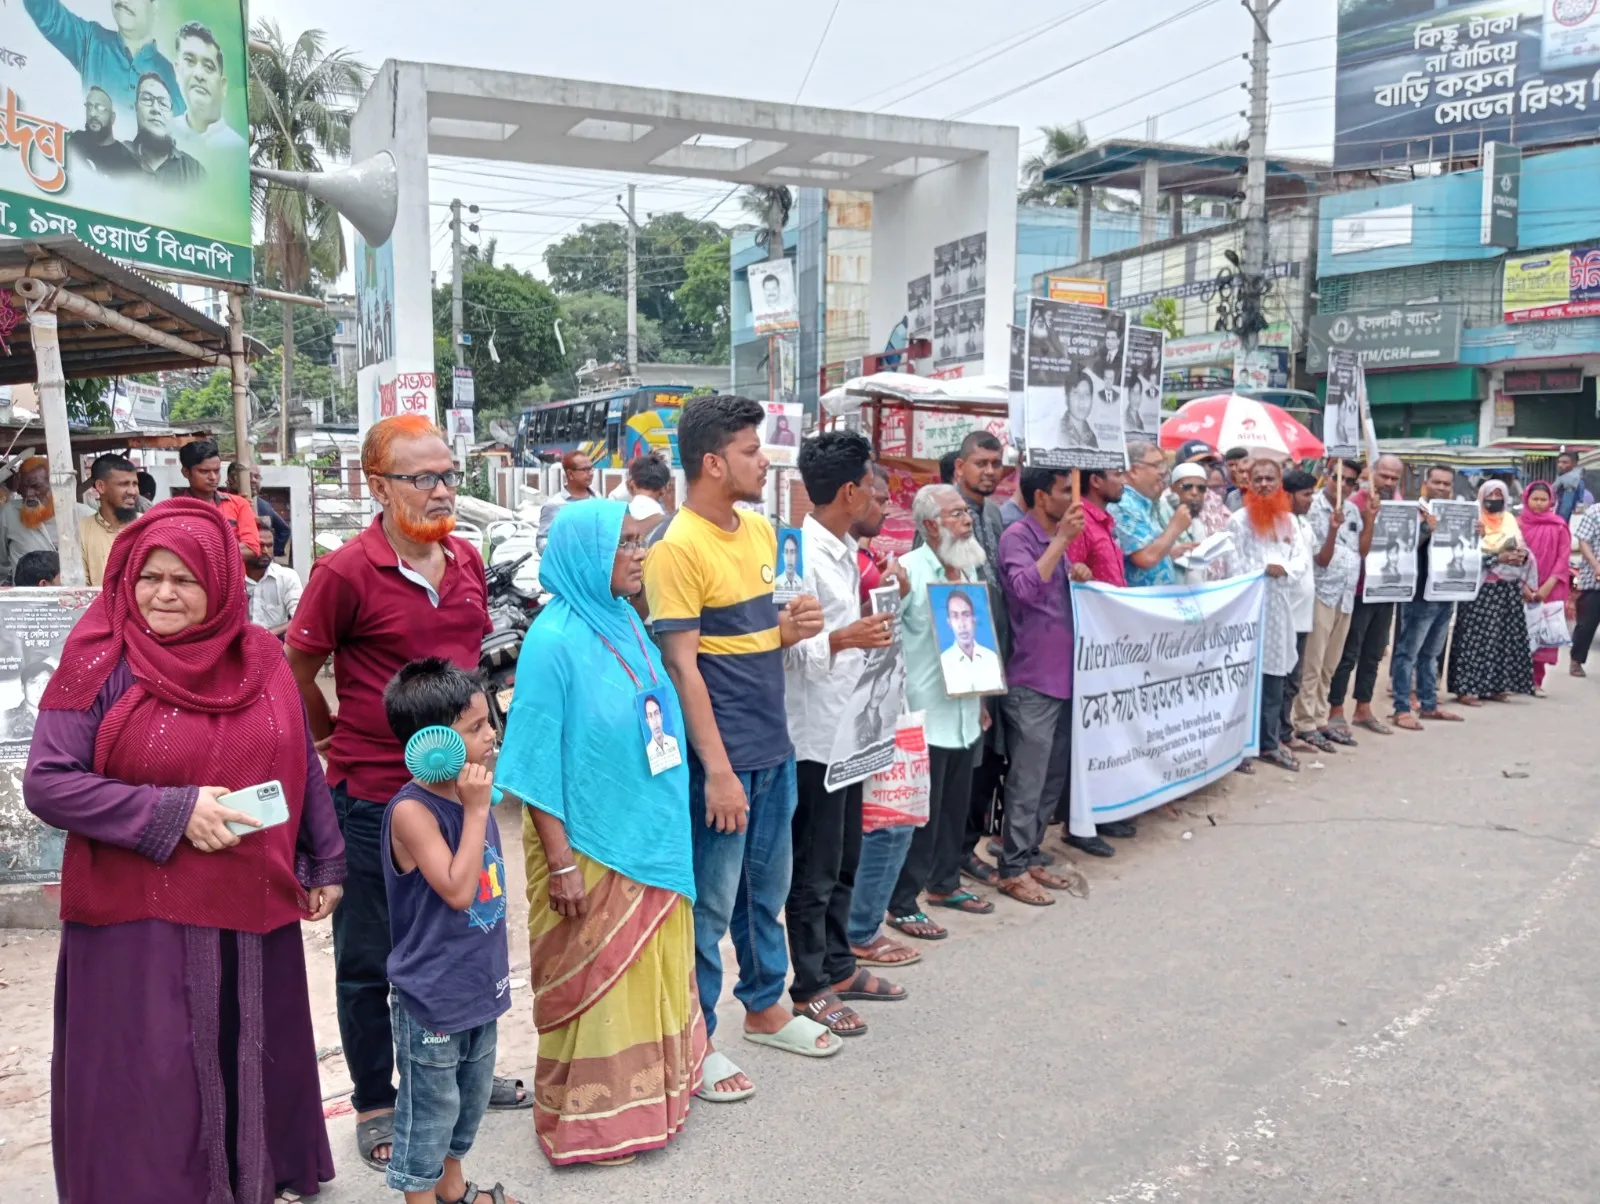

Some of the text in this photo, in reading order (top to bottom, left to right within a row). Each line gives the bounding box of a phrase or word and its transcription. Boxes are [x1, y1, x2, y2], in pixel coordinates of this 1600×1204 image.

[1414, 22, 1460, 52] কিছু
[1469, 13, 1521, 39] টাকা
[1426, 40, 1518, 73] না বাঁচিয়ে
[1374, 64, 1516, 108] বাড়ি করুন
[1435, 92, 1515, 124] সেভেন
[1520, 78, 1587, 111] রিংস্
[30, 208, 77, 234] ৯নং
[89, 224, 150, 253] ওয়ার্ড
[156, 230, 234, 272] বিএনপি
[1357, 310, 1402, 331] ইসলামী
[1237, 432, 1267, 441] airtel
[1080, 692, 1109, 728] মের
[1165, 723, 1182, 737] those
[1182, 712, 1213, 733] Involved
[1213, 710, 1221, 722] in
[1088, 749, 1132, 771] Enforced
[1189, 732, 1197, 743] to
[422, 1034, 450, 1045] JORDAN
